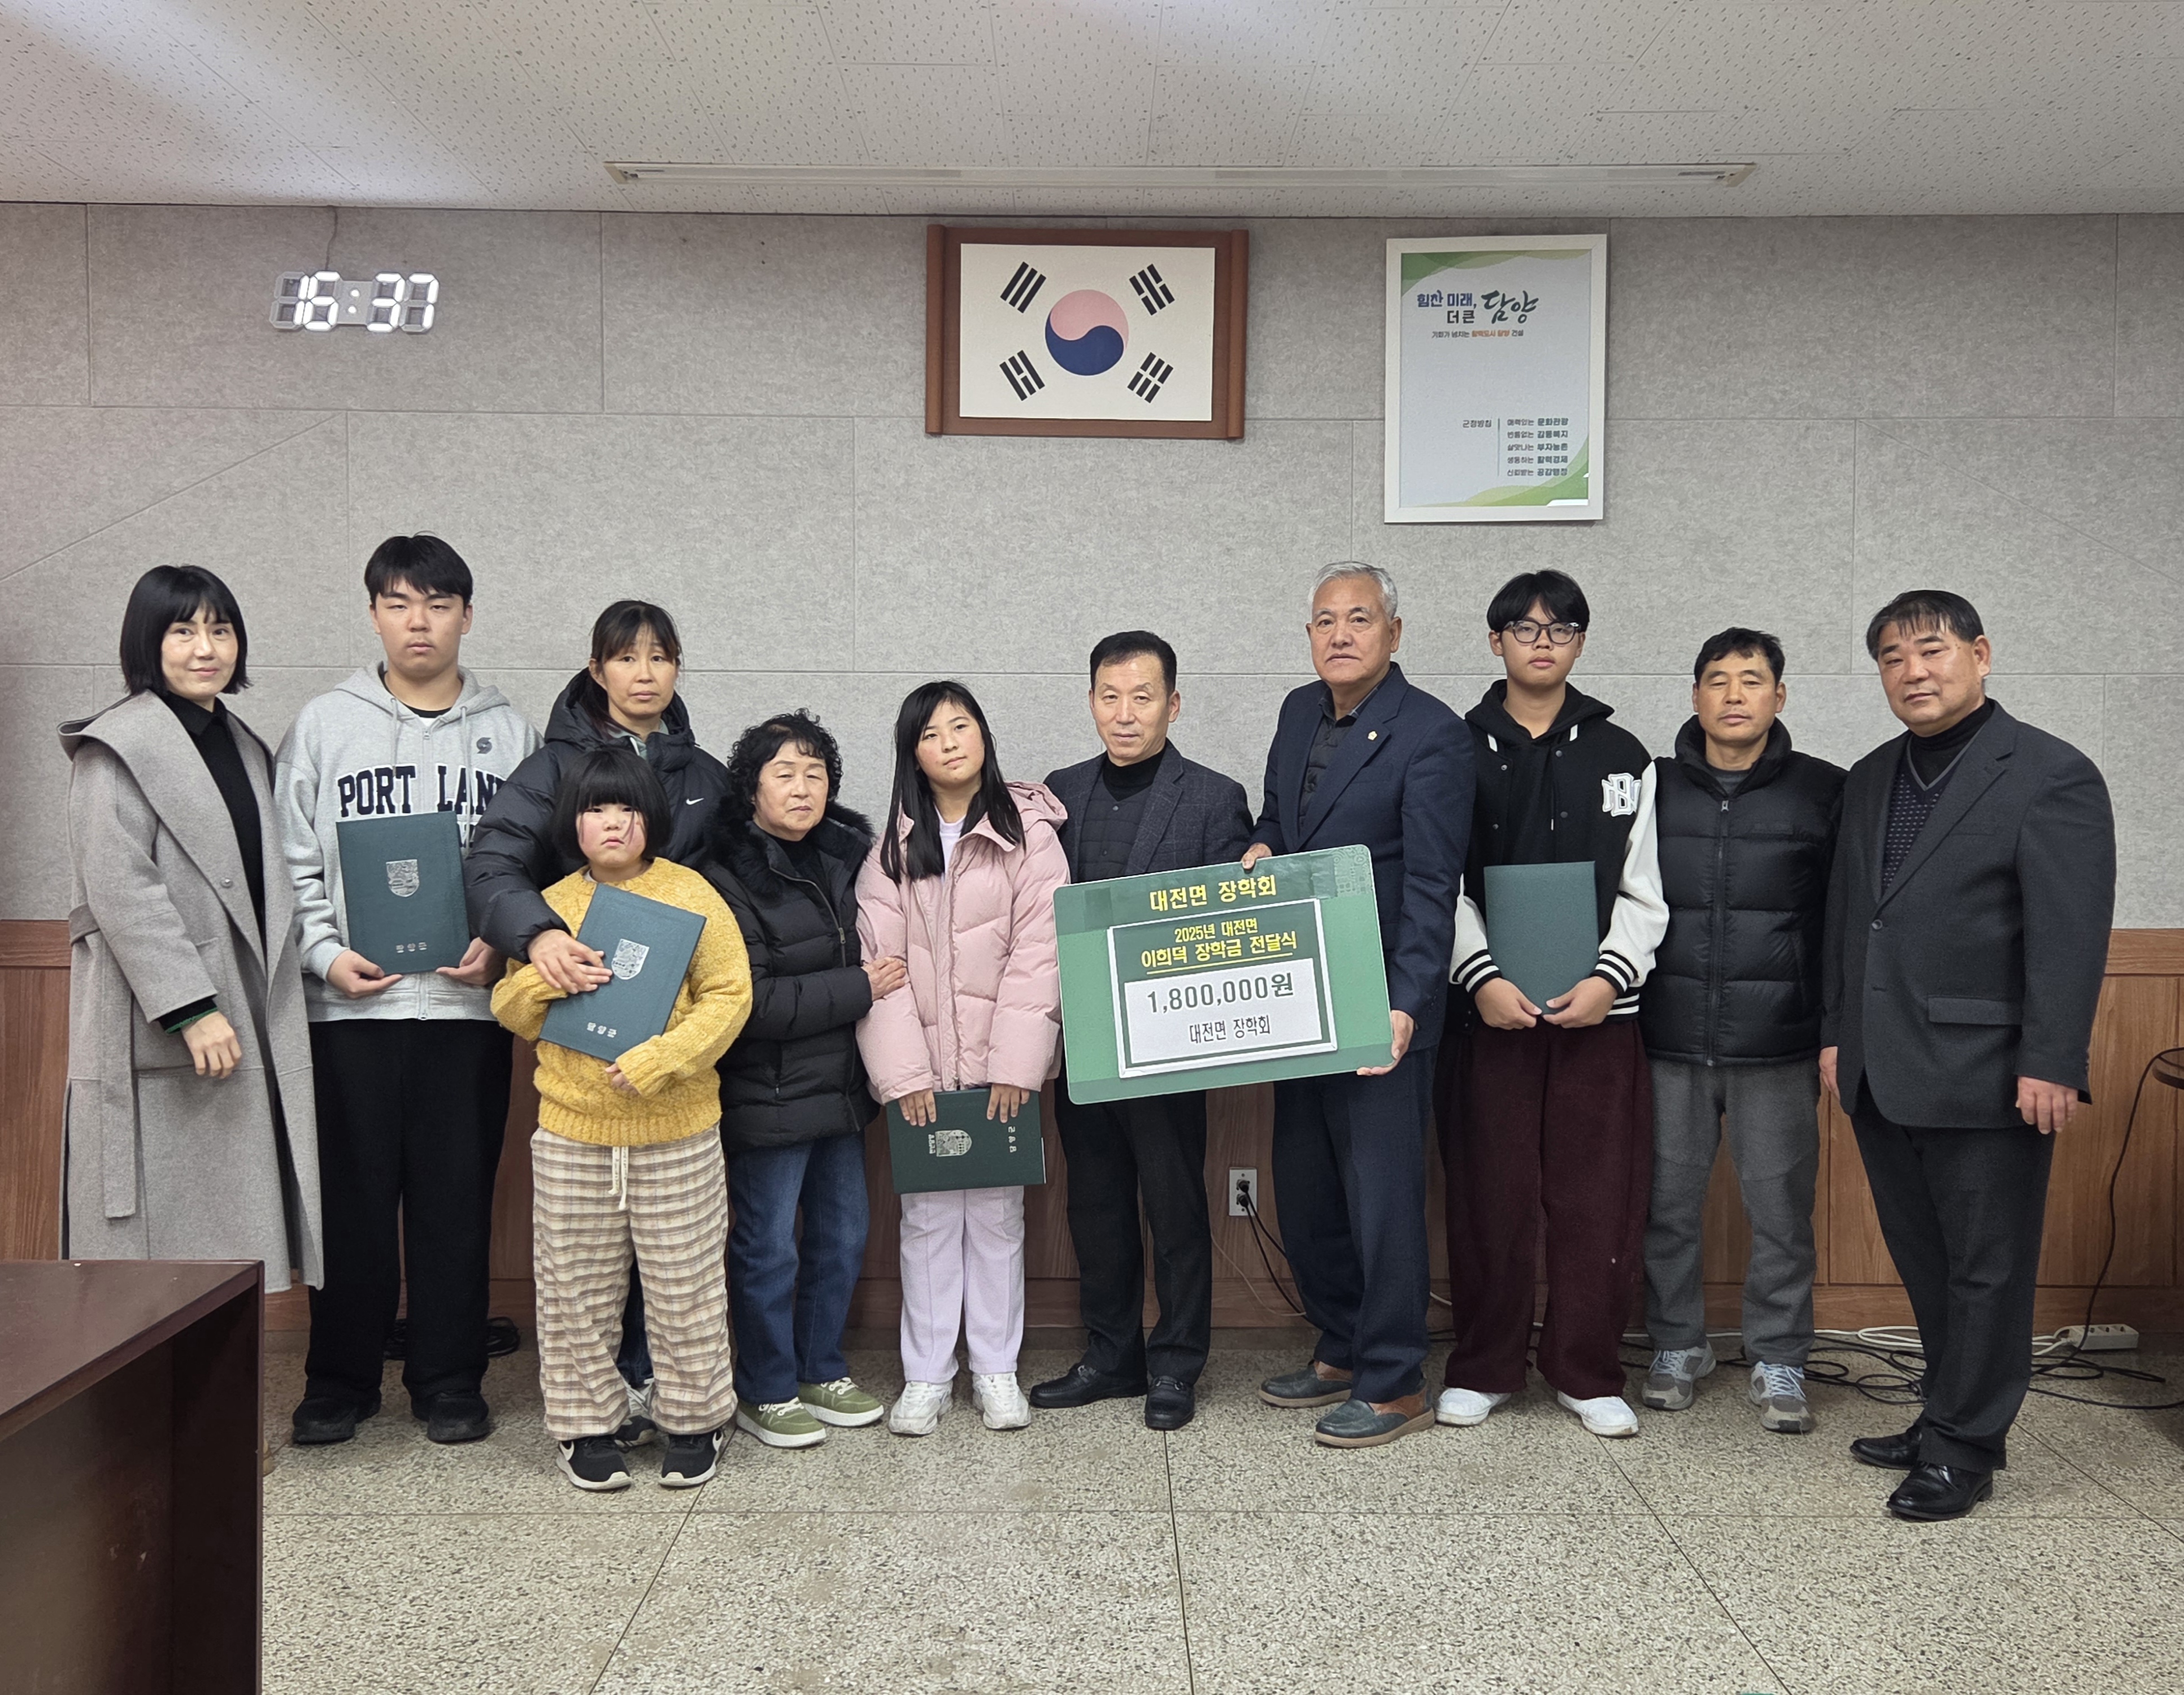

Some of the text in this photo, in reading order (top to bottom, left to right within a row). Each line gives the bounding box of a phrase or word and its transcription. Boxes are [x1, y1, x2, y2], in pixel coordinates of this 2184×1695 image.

[293, 271, 439, 332] 16:37
[1417, 290, 1477, 309] 힘찬 미래,
[1447, 290, 1539, 324] 더 큰 담양
[337, 764, 507, 818] PORT LAN
[1150, 875, 1277, 911] 대전면 장학회
[1174, 918, 1258, 943] 2025년 대전면
[1141, 931, 1297, 968] 이희덕 장학금 전달식
[1147, 972, 1294, 1014] 1,800,000원
[1189, 1015, 1271, 1044] 대전면 장학회
